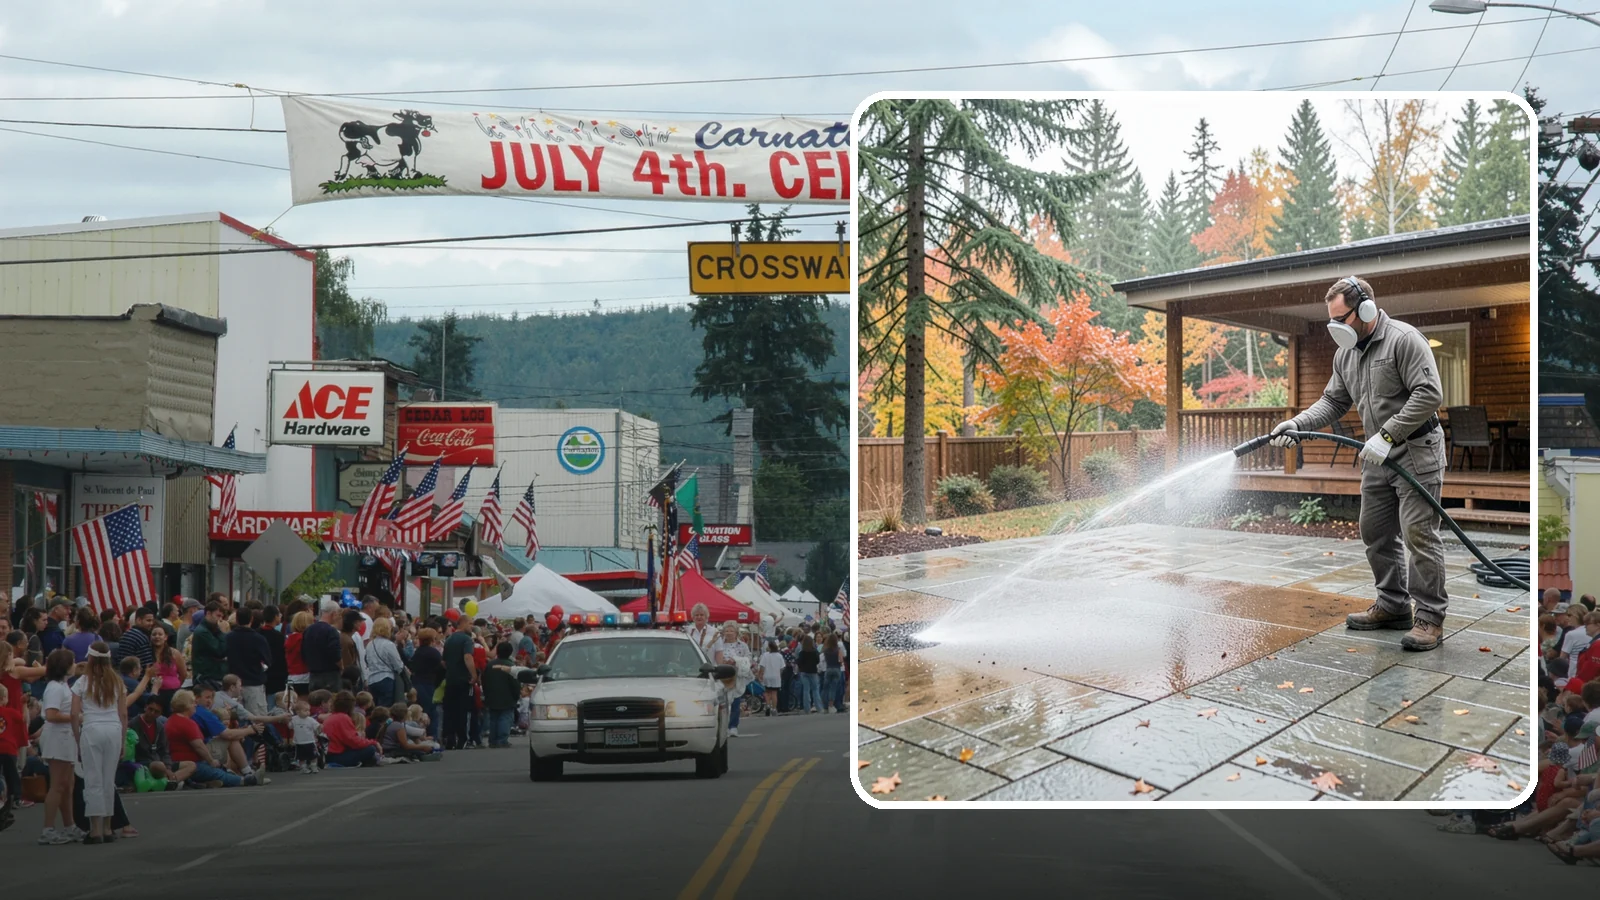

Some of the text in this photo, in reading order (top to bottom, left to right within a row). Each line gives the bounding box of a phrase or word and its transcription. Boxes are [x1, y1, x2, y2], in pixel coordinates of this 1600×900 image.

[481, 141, 605, 192] JULY
[632, 150, 746, 197] 4th.
[697, 255, 850, 280] CROSSWA
[283, 380, 373, 420] ACE
[406, 410, 485, 421] CEDAR LOG
[283, 421, 371, 437] Hardware
[416, 428, 477, 446] Coca-Cola
[353, 467, 384, 480] Simpl
[83, 484, 155, 495] St. Vincent de Paul
[212, 516, 330, 535] HARDARE
[688, 526, 741, 535] CRNATION
[699, 535, 730, 543] GLASS
